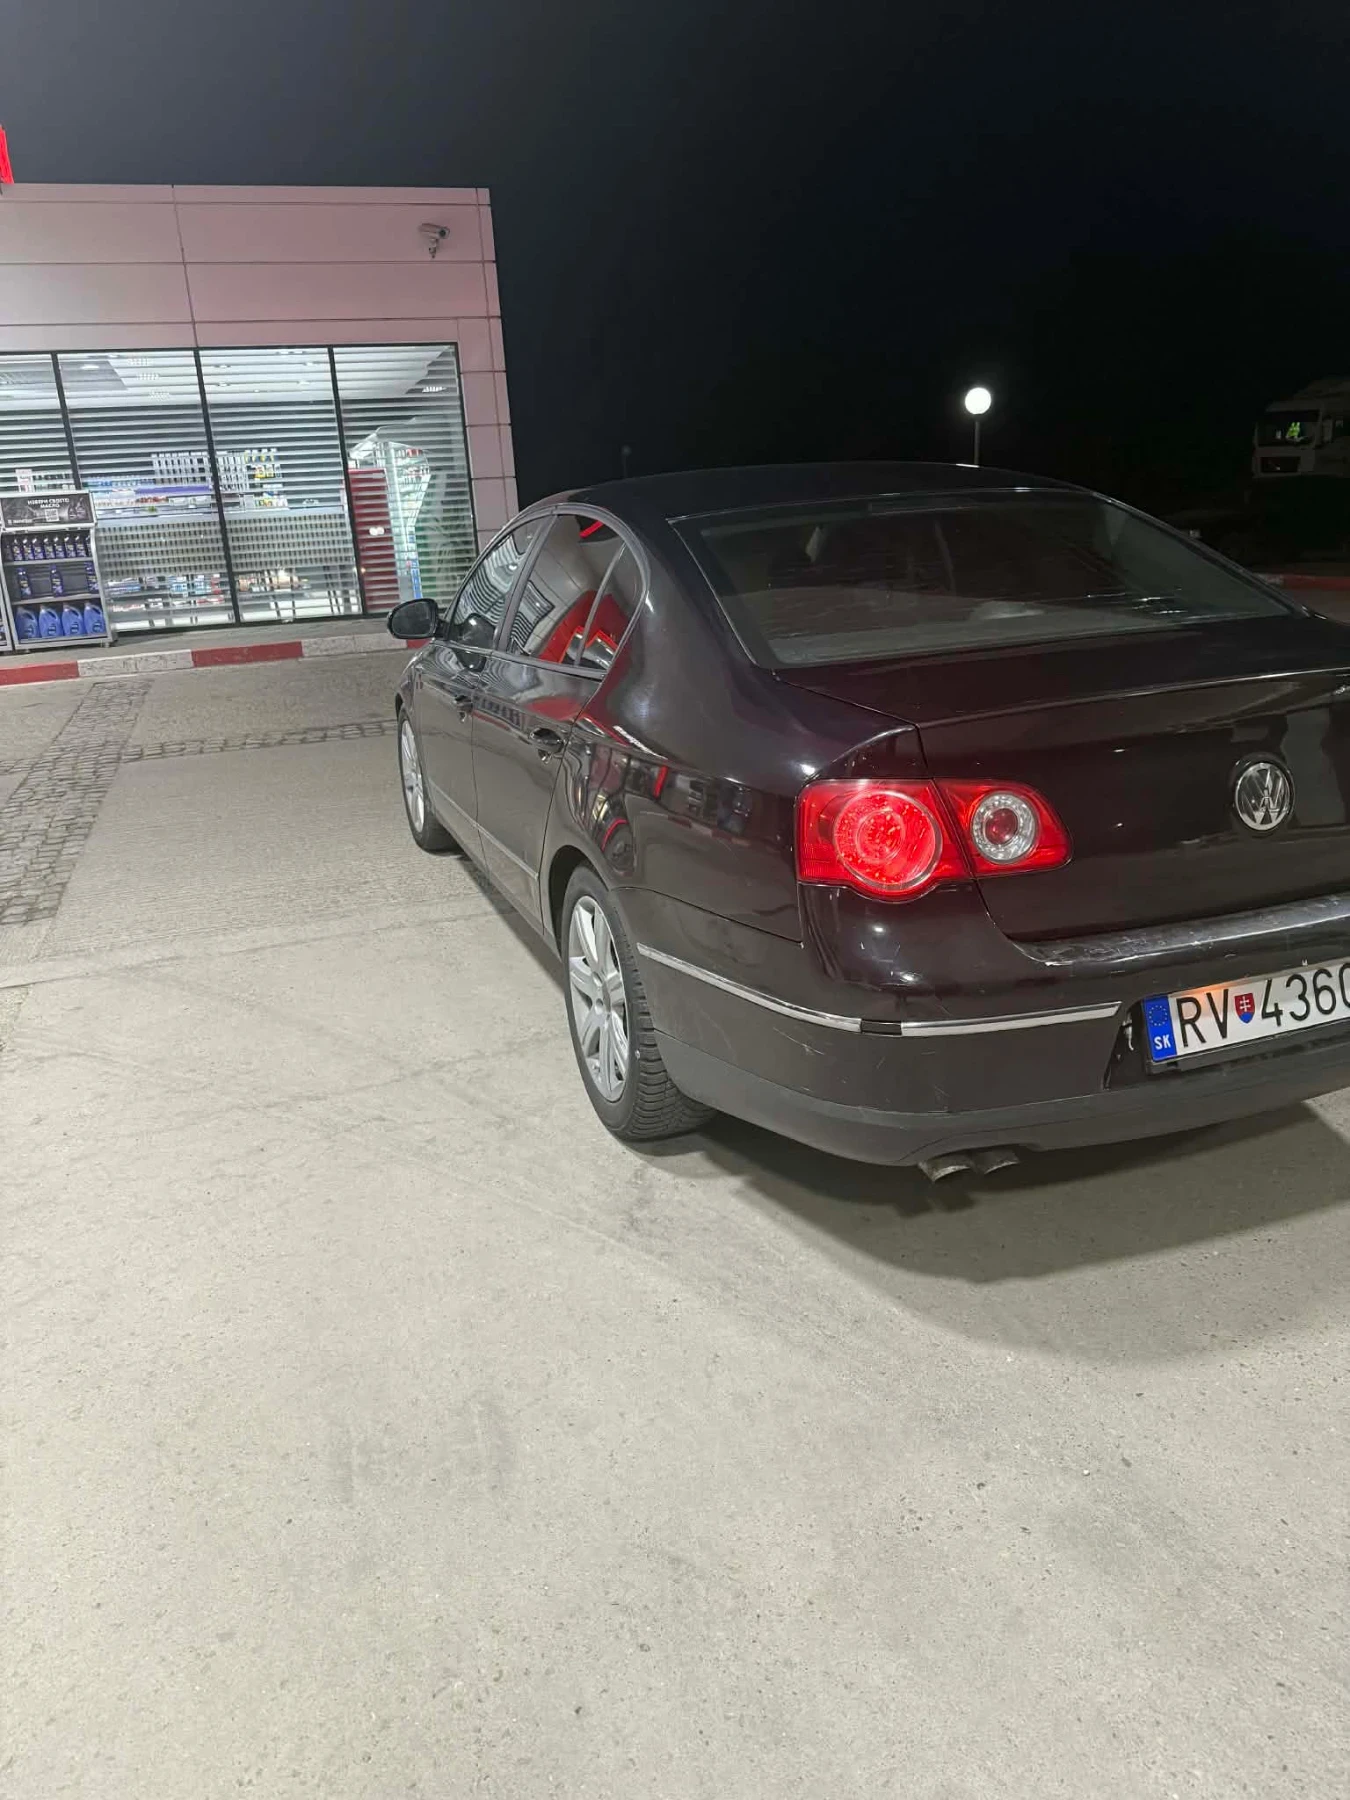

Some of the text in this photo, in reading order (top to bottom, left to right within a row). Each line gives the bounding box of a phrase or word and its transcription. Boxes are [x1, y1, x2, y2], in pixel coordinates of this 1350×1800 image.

[1236, 762, 1290, 831] VW
[1154, 1034, 1171, 1050] SK
[1176, 988, 1229, 1047] RV
